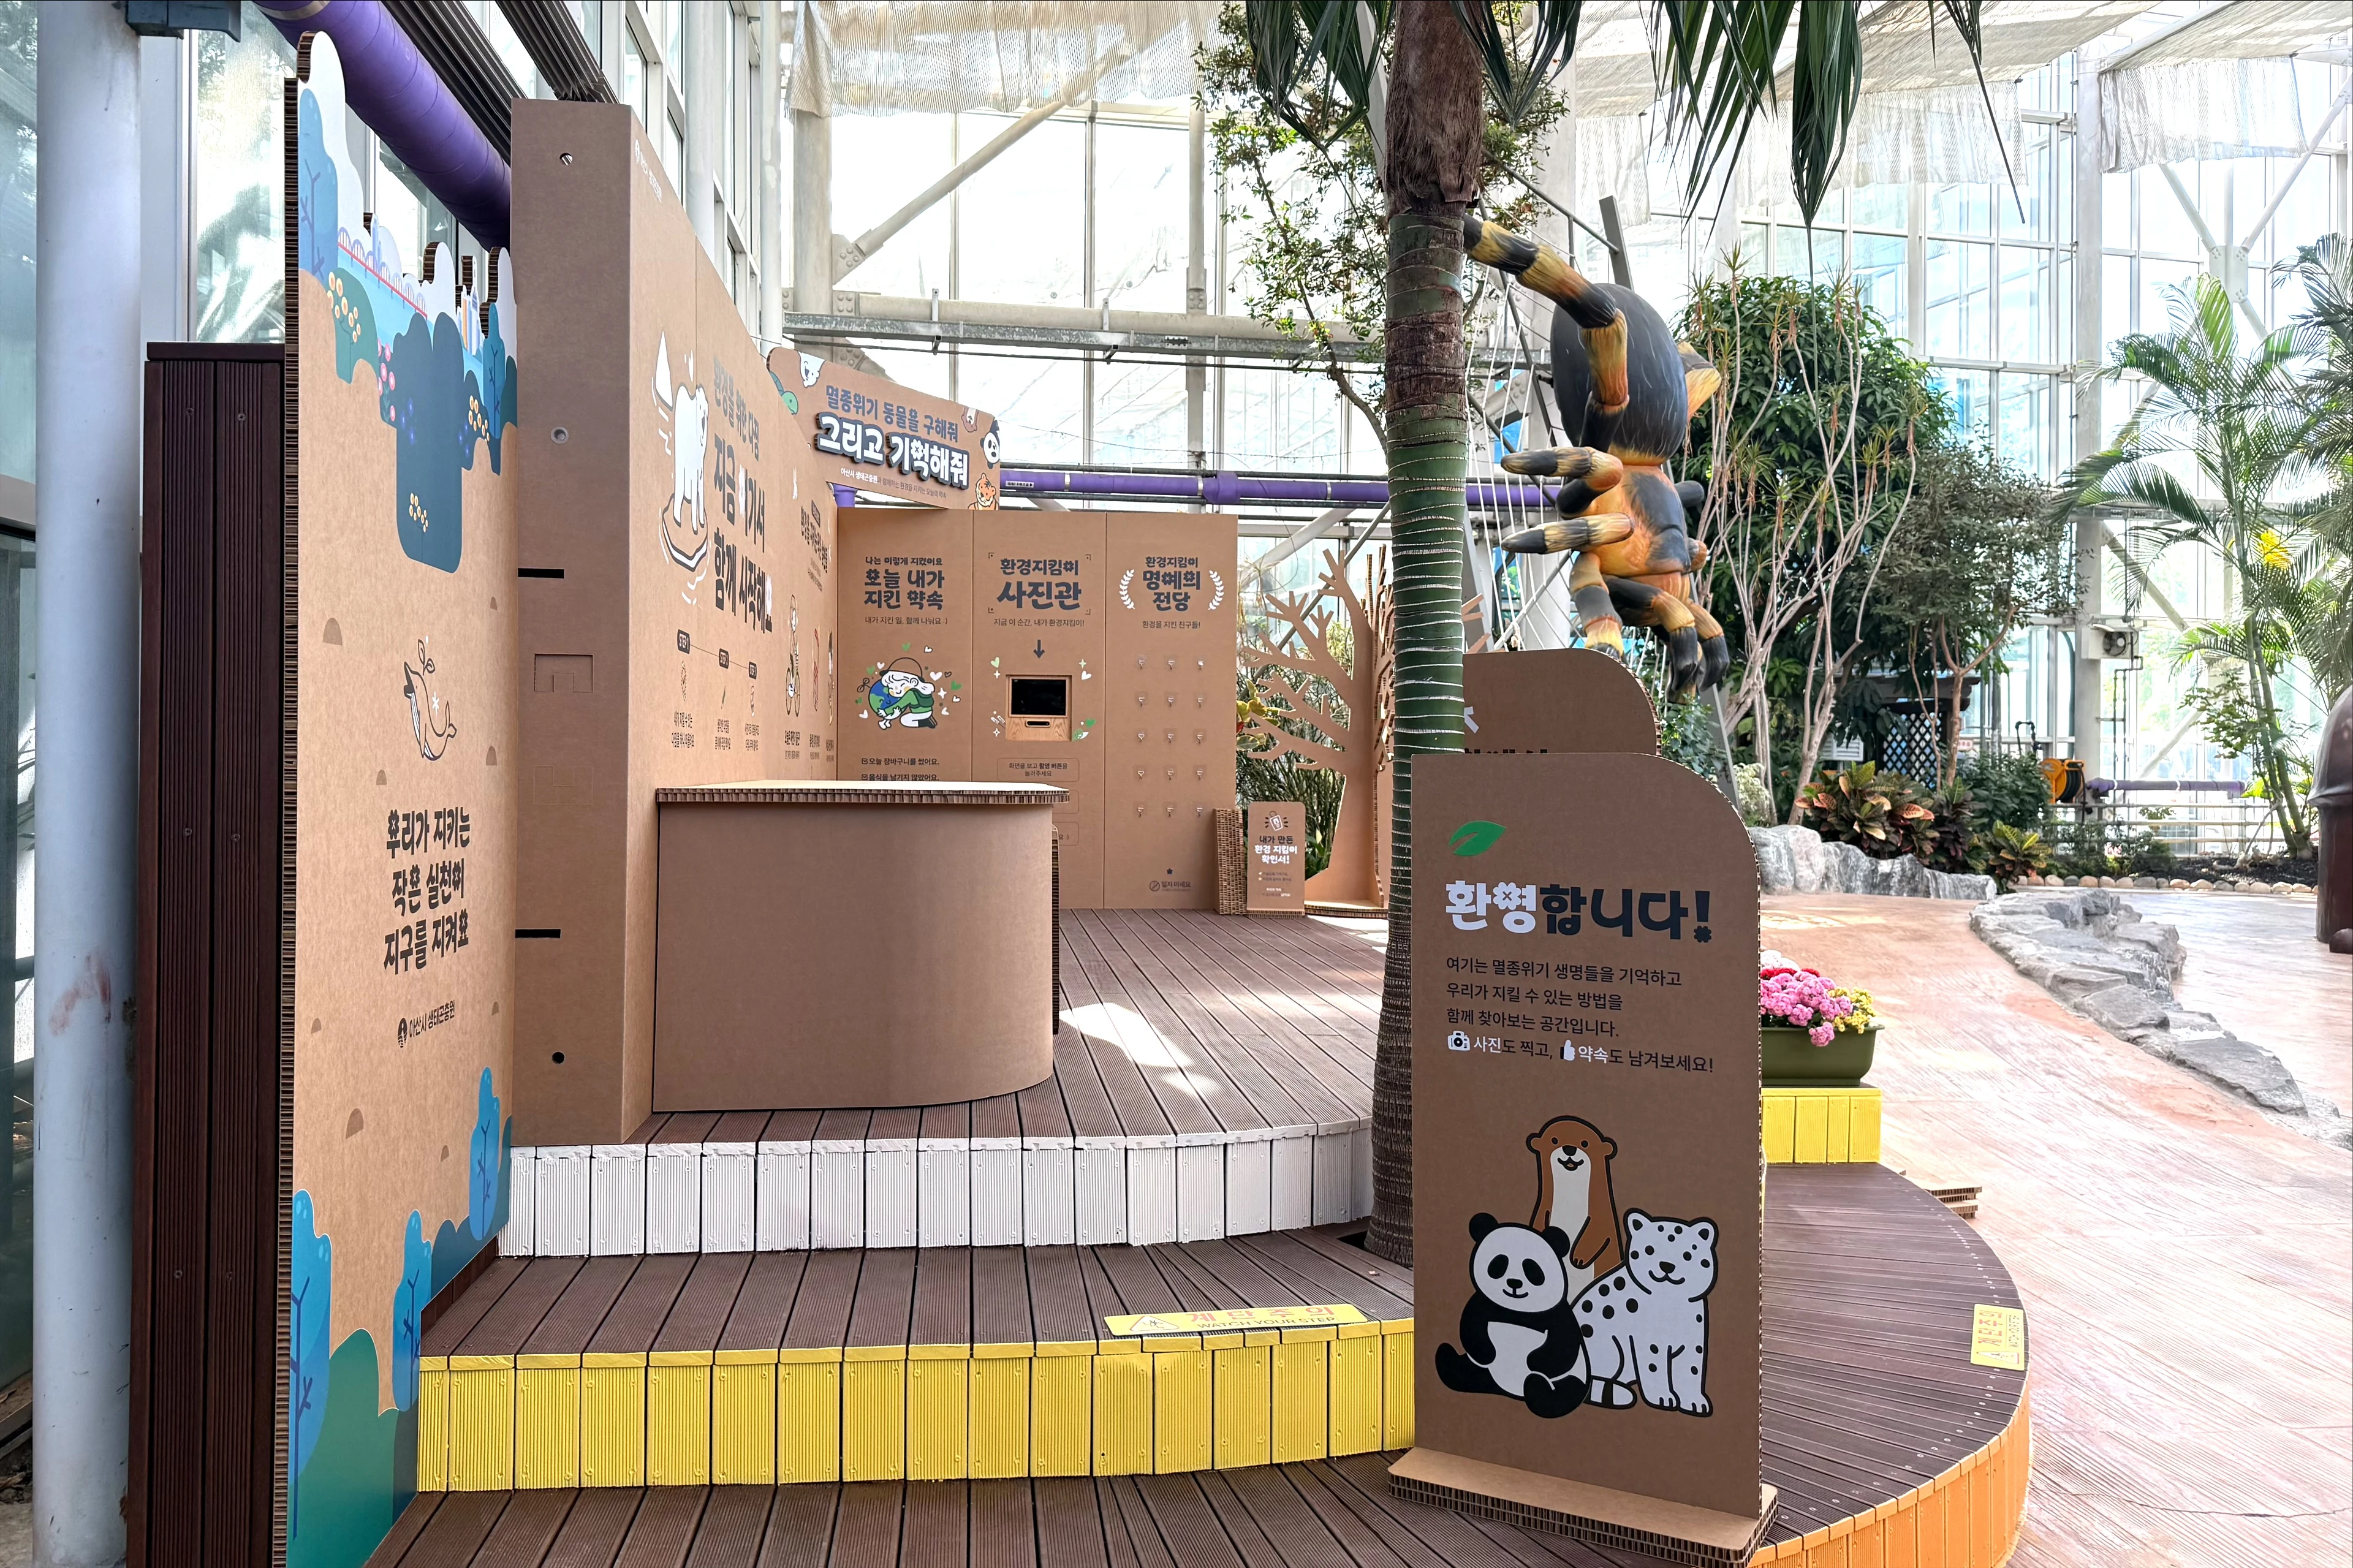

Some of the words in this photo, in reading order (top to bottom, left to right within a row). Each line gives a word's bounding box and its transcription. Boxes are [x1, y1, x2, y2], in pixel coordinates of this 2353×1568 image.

[714, 355, 734, 428] 환경을
[736, 388, 746, 443] 위한
[749, 411, 759, 461] 다짐
[826, 385, 878, 420] 멸종위기
[882, 402, 919, 433] 동물을
[923, 415, 958, 442] 구해줘
[818, 414, 884, 463] 그리고
[888, 433, 968, 487] 기억해줘
[714, 433, 735, 525] 지금
[841, 468, 855, 478] 아산시
[865, 556, 881, 566] 나는
[884, 557, 908, 566] 이렇게
[911, 557, 942, 566] 지켰어요
[1000, 558, 1078, 576] 환경지킴이
[1145, 556, 1199, 568] 환경지킴이
[714, 526, 737, 616] 함께
[739, 555, 772, 633] 시작해요
[865, 569, 900, 589] 오늘
[907, 570, 945, 589] 내가
[1143, 570, 1200, 591] 명예의
[864, 590, 901, 609] 지킨
[907, 590, 944, 610] 약속
[996, 581, 1082, 610] 사진관
[1153, 592, 1191, 612] 전당
[1017, 618, 1032, 627] 순간,
[387, 809, 430, 859] 우리가
[433, 806, 471, 850] 지키는
[1259, 835, 1275, 844] 내가
[1254, 844, 1271, 854] 환경
[1273, 845, 1297, 854] 지킴이
[1262, 855, 1290, 864] 확인서!
[392, 863, 422, 917] 작은
[426, 858, 464, 911] 실천이
[1445, 879, 1713, 943] 환영합니다!
[384, 919, 428, 975] 지구를
[432, 907, 469, 958] 지켜요
[1446, 956, 1488, 974] 여기는
[1492, 958, 1550, 979] 멸종위기
[1555, 963, 1615, 983] 생명들을
[1619, 968, 1682, 987] 기억하고
[1446, 983, 1488, 1001] 우리가
[1492, 986, 1521, 1003] 지킬
[1525, 988, 1539, 1004] 수
[1544, 989, 1573, 1007] 있는
[1577, 991, 1623, 1011] 방법을
[409, 1015, 427, 1038] 아산시
[428, 999, 455, 1031] 생태곤충원
[1447, 1008, 1474, 1026] 함께
[1478, 1011, 1536, 1031] 찾아보는
[1540, 1015, 1619, 1038] 공간입니다.
[1474, 1036, 1516, 1055] 사진도
[1520, 1040, 1553, 1059] 찍고,
[1578, 1045, 1624, 1065] 약속도
[1628, 1050, 1714, 1074] 남겨보세요!
